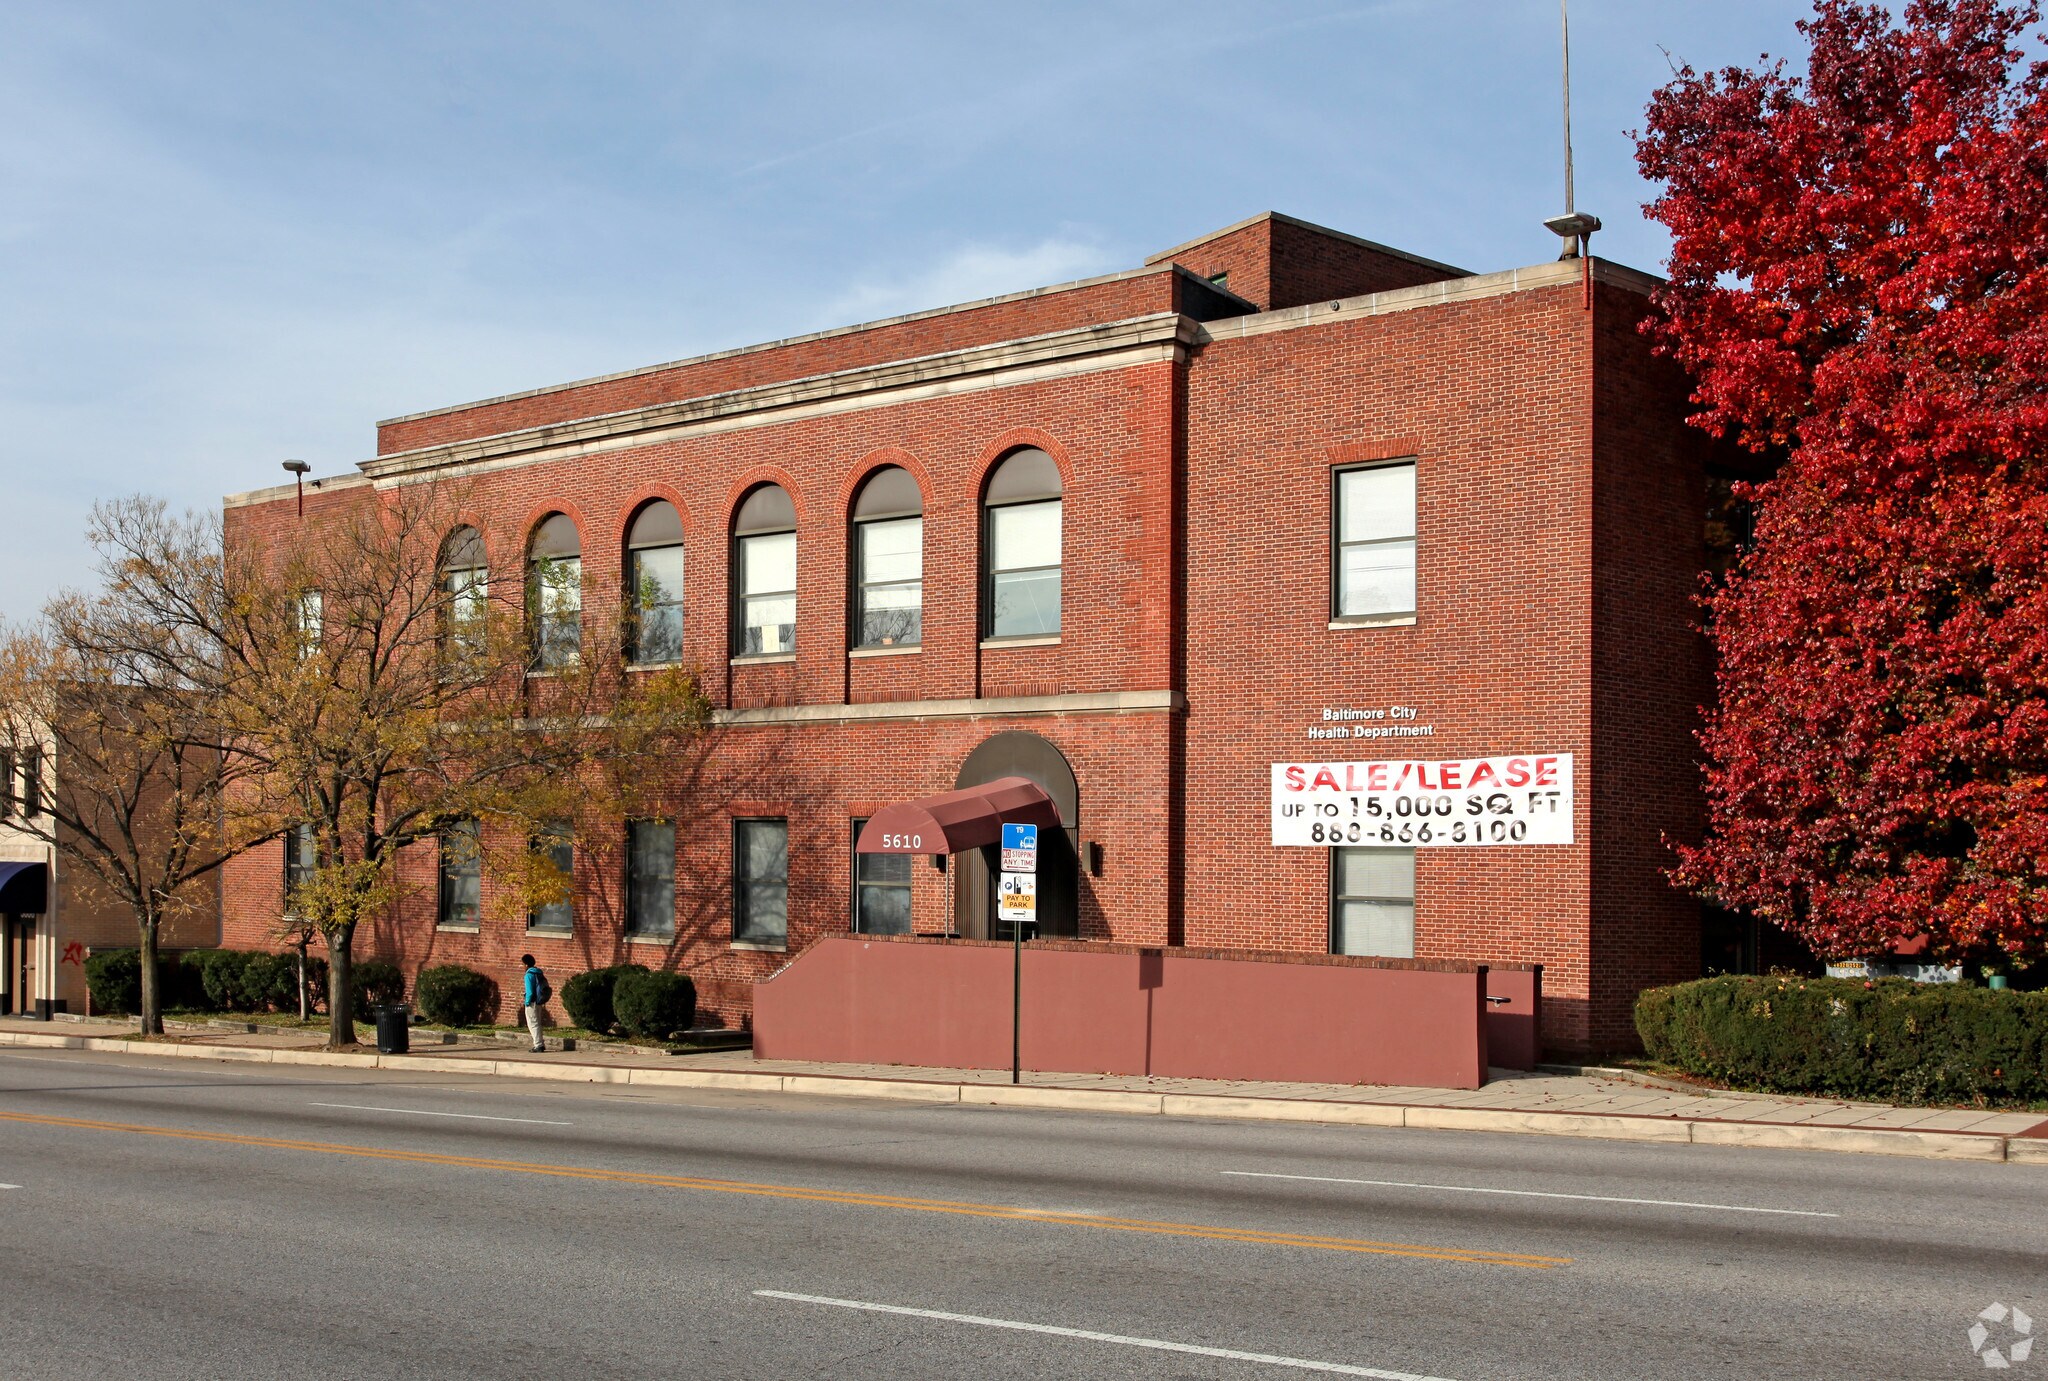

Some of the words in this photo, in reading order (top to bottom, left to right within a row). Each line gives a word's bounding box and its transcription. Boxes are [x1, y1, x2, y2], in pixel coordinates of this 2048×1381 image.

[1322, 707, 1385, 721] Baltimore
[1390, 705, 1417, 721] City
[1308, 726, 1349, 739] Health
[1354, 724, 1434, 740] Department
[1284, 757, 1559, 792] SALE/LEASE
[1281, 803, 1306, 818] UP
[1314, 803, 1339, 818] TO
[1350, 795, 1452, 821] 15,000
[1466, 792, 1514, 816] SQ
[1528, 791, 1561, 814] FT
[1311, 819, 1527, 843] 888-866-8100
[882, 834, 921, 849] 5610
[1012, 850, 1034, 859] STOPPING
